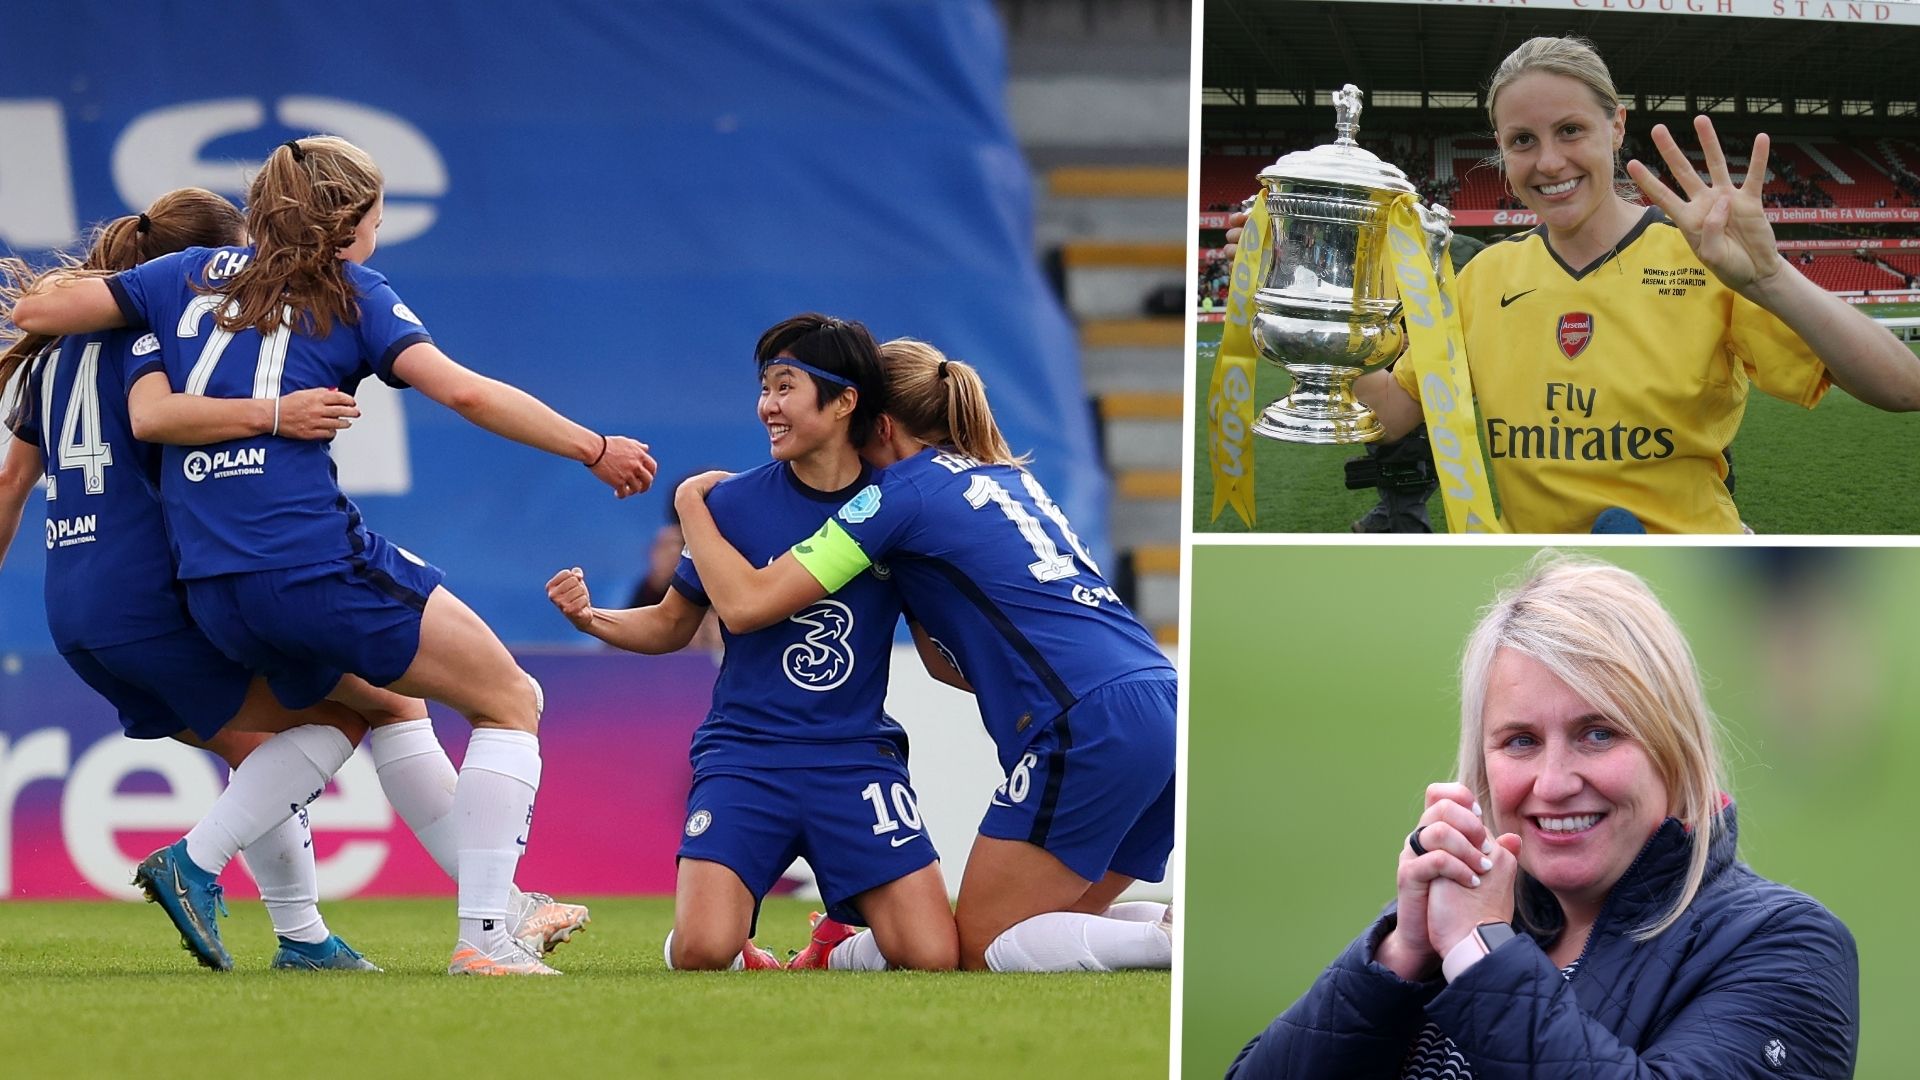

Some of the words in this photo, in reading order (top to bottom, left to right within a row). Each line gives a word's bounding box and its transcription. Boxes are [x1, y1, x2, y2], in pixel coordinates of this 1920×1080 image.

[1772, 0, 1890, 21] STAND
[1782, 208, 1817, 220] behind
[1819, 208, 1838, 220] The
[1840, 209, 1853, 219] FA
[1855, 208, 1899, 219] Women's
[1901, 208, 1919, 221] Cup
[1643, 267, 1669, 277] WOMENS
[1677, 268, 1688, 276] CUP
[1689, 267, 1706, 276] FINAL
[1641, 278, 1667, 286] ARSENAL
[1676, 278, 1706, 287] CHARLTON
[1658, 288, 1671, 296] MAY
[1672, 288, 1687, 297] 2007
[1562, 321, 1589, 329] Arsenal
[1546, 382, 1597, 418] Fly
[1486, 415, 1675, 461] Emirates
[213, 448, 266, 470] PLAN
[213, 467, 264, 479] INTERNATIONAL
[57, 514, 97, 538] PLAN
[59, 534, 97, 547] INTERNATIONAL
[861, 782, 922, 836] 10
